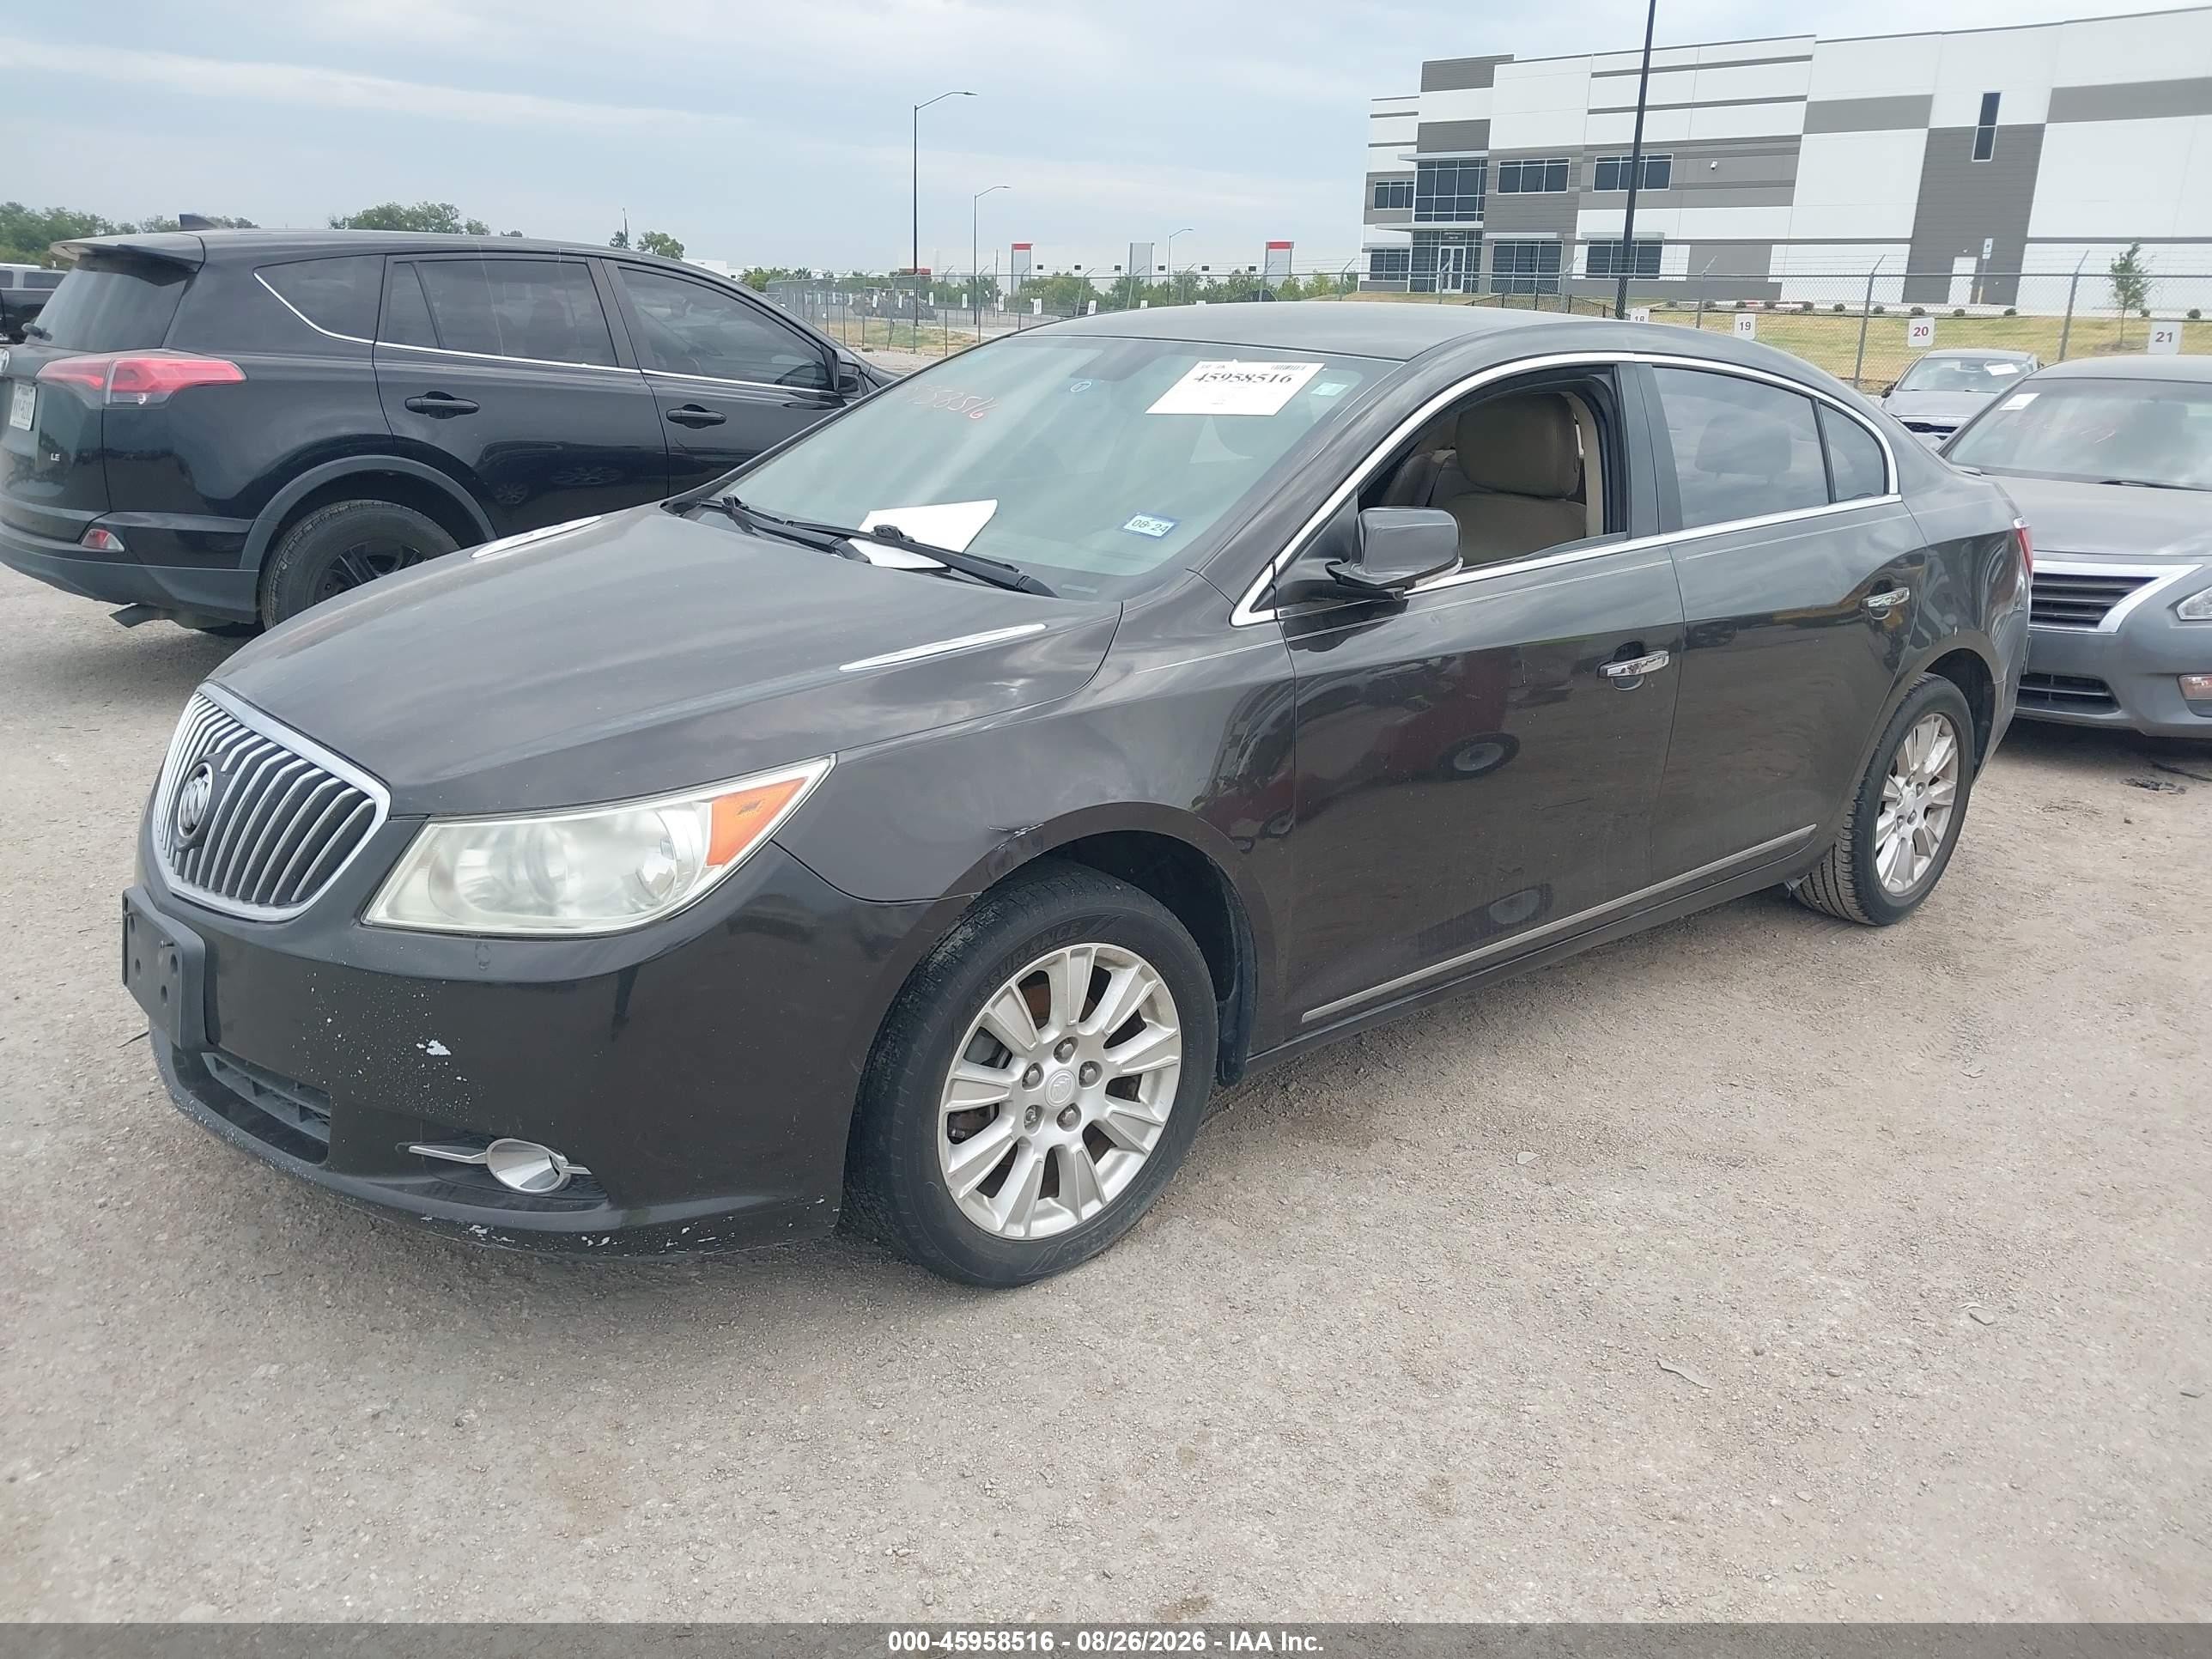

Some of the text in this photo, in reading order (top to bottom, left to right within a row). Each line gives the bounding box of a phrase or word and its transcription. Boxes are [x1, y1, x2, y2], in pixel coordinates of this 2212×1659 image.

[1739, 321, 1752, 331] 19
[1912, 326, 1929, 337] 20
[2155, 331, 2173, 343] 21
[1194, 372, 1292, 383] 45958516
[50, 453, 60, 461] LE
